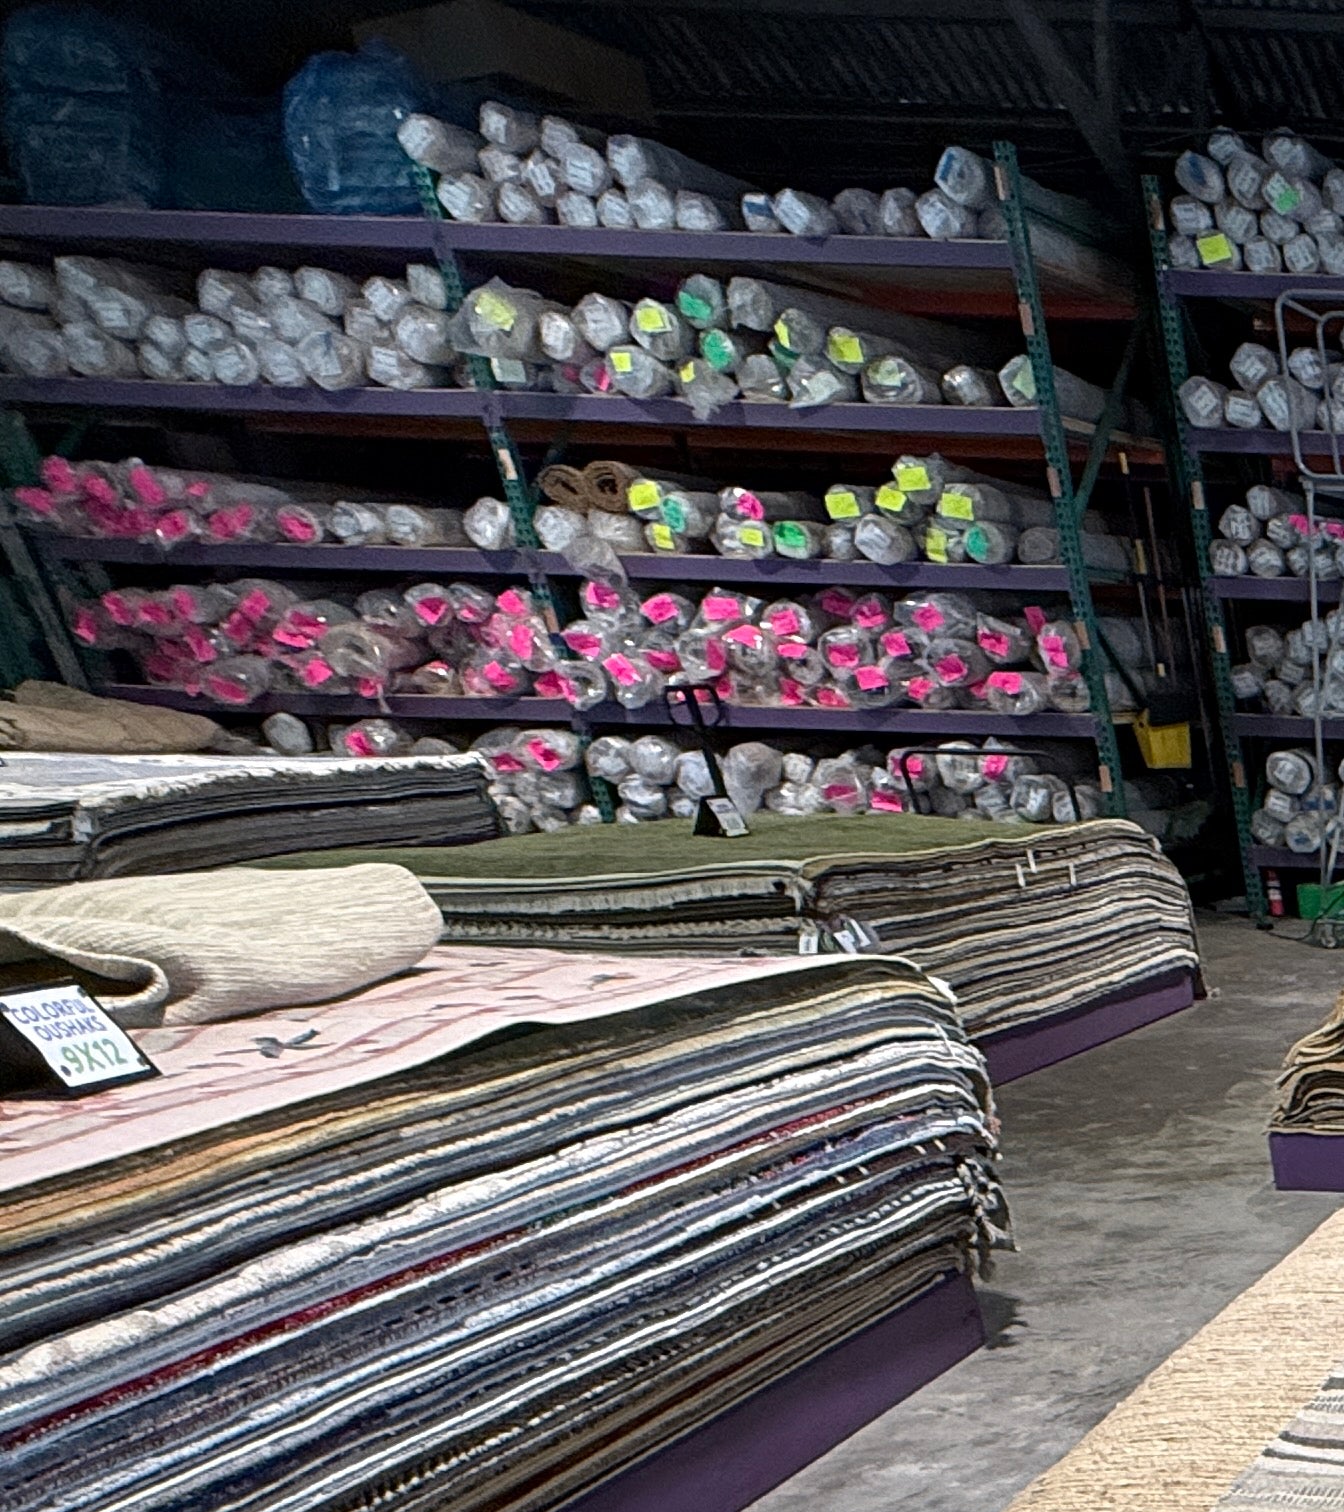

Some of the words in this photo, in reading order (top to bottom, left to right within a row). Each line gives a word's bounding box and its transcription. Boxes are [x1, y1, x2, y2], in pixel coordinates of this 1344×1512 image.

[9, 999, 96, 1025] COLORFUL
[33, 1015, 108, 1042] OUSHAKS
[60, 1038, 129, 1074] 9X12
